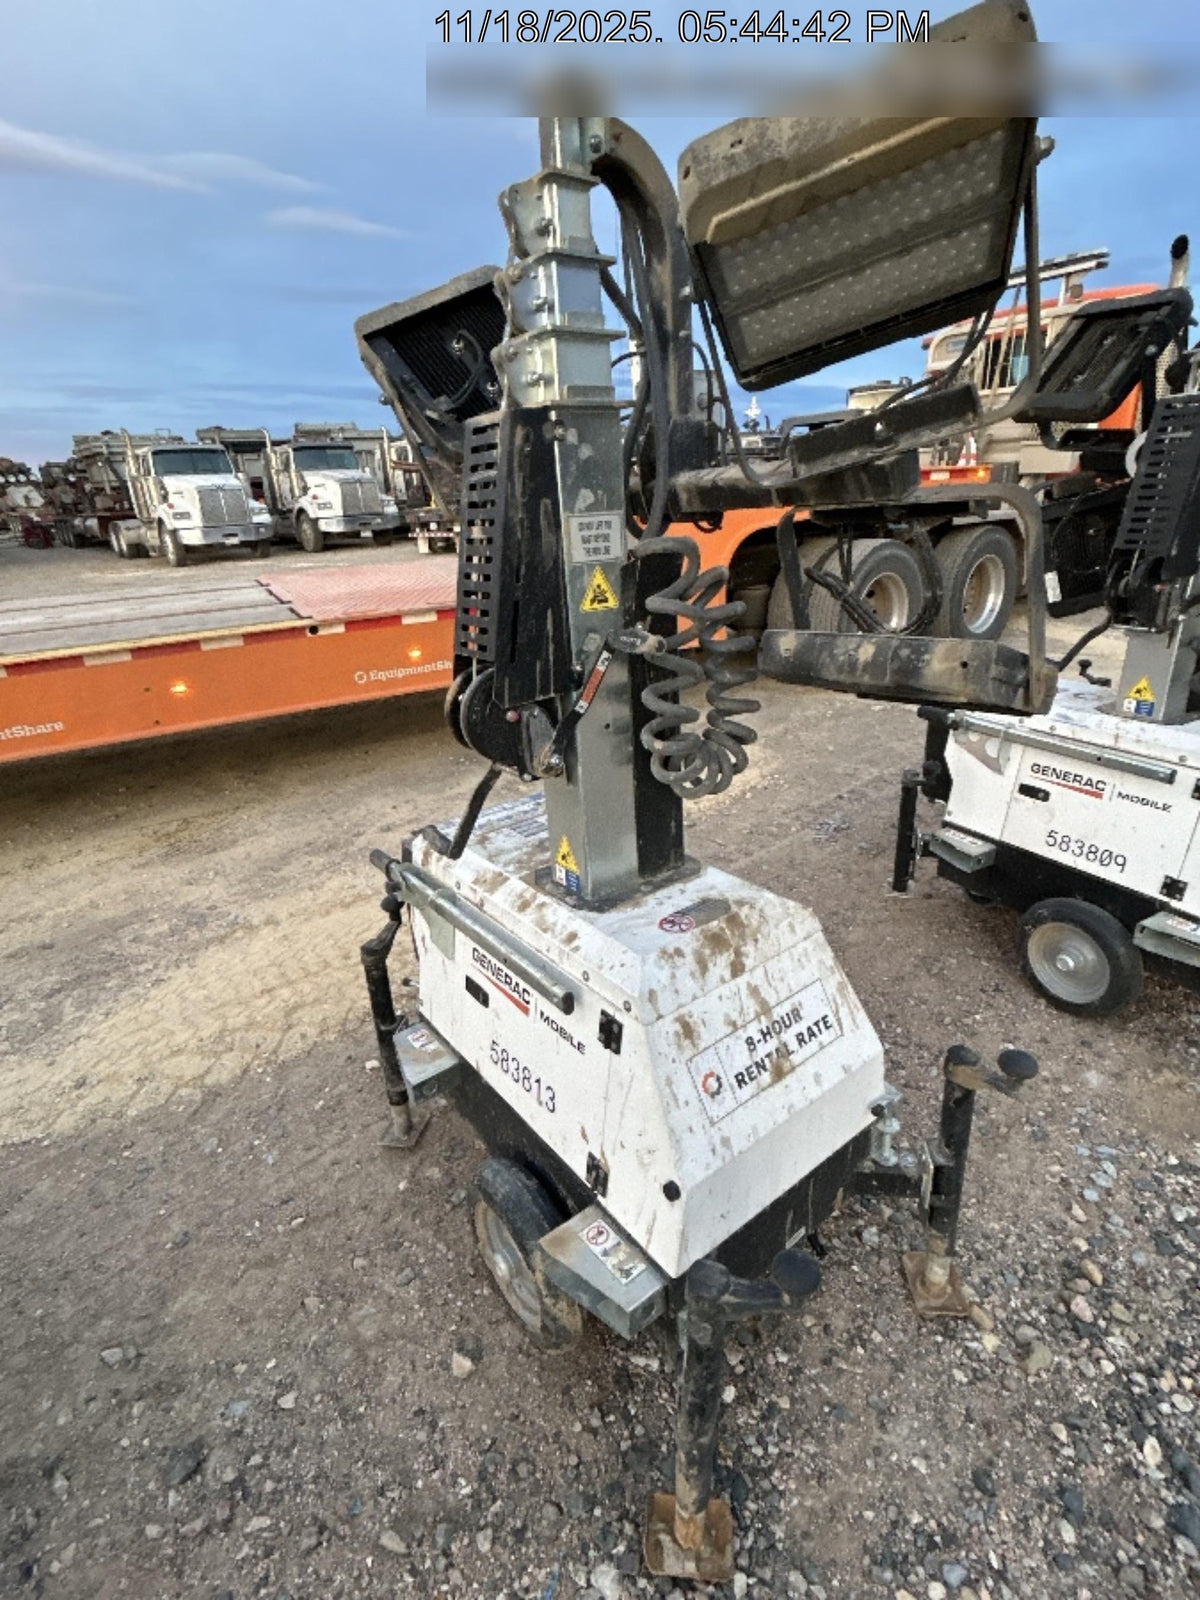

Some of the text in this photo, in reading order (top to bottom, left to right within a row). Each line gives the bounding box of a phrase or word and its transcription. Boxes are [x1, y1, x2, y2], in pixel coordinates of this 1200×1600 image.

[1031, 763, 1172, 813] GENERAC MOBILE
[1045, 830, 1127, 873] 583809
[472, 947, 586, 1055] GENERAC MOBILE
[745, 1007, 803, 1053] 8-HOUR
[490, 1039, 556, 1113] 583813
[734, 1014, 833, 1089] RENTAL RATE
